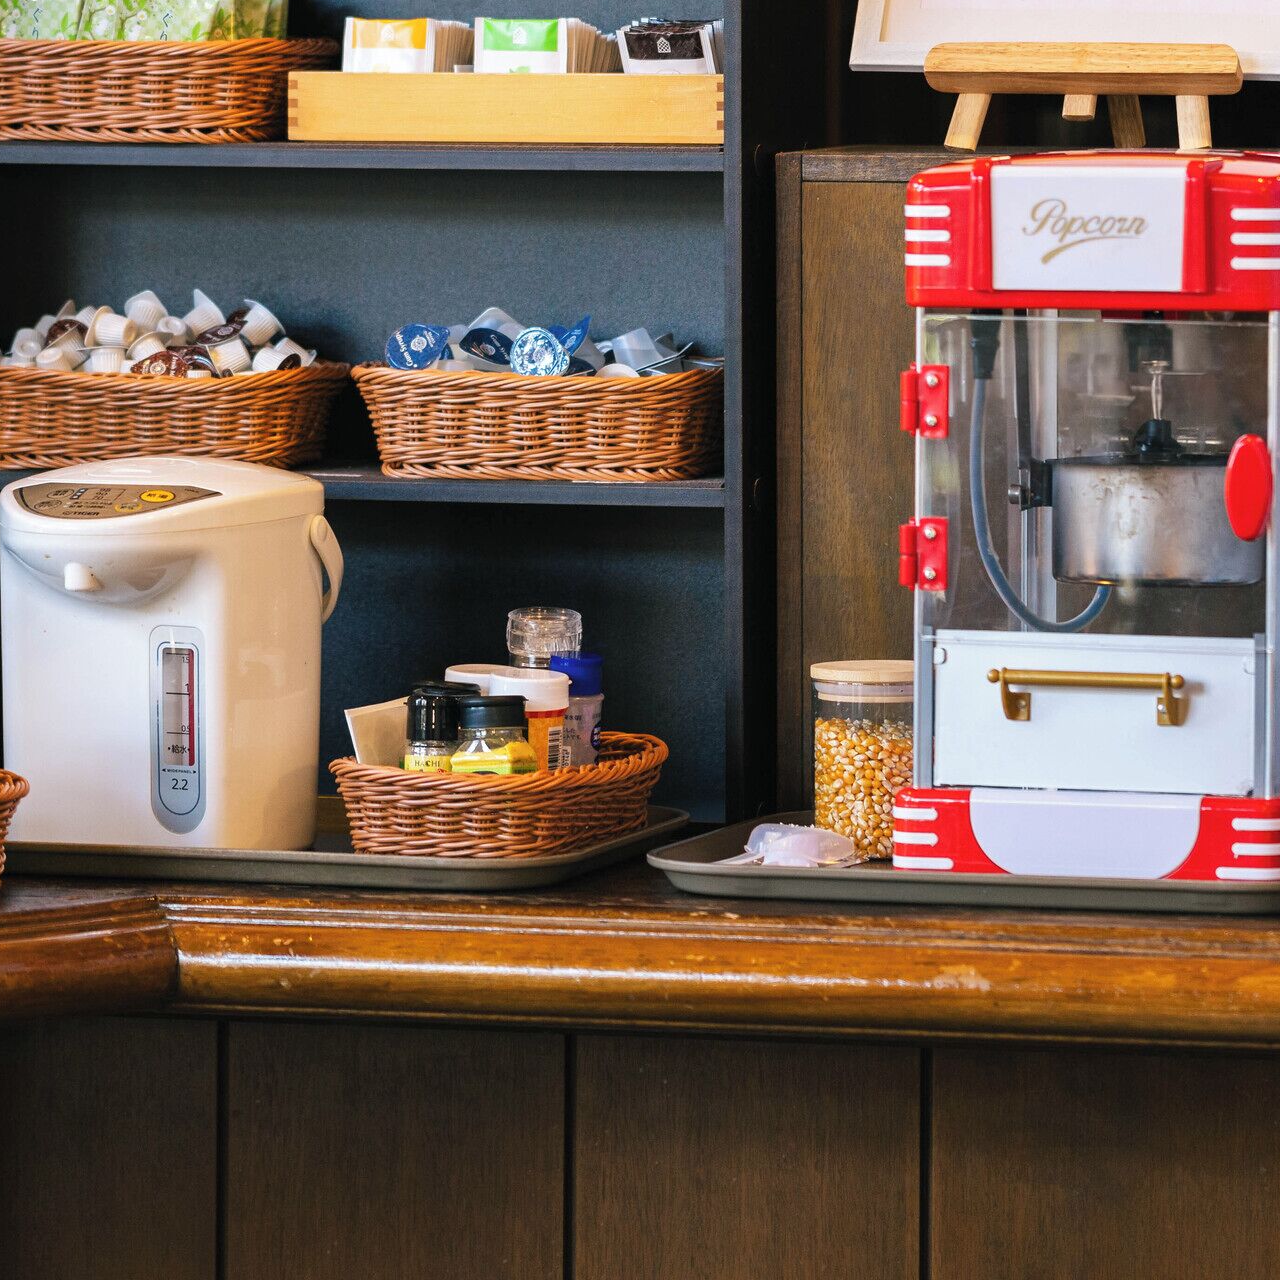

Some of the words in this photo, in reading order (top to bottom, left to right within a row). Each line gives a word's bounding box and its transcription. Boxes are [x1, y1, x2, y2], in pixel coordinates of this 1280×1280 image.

[1022, 198, 1149, 243] Popcorn
[414, 760, 440, 768] HACHI
[171, 778, 189, 791] 2.2
